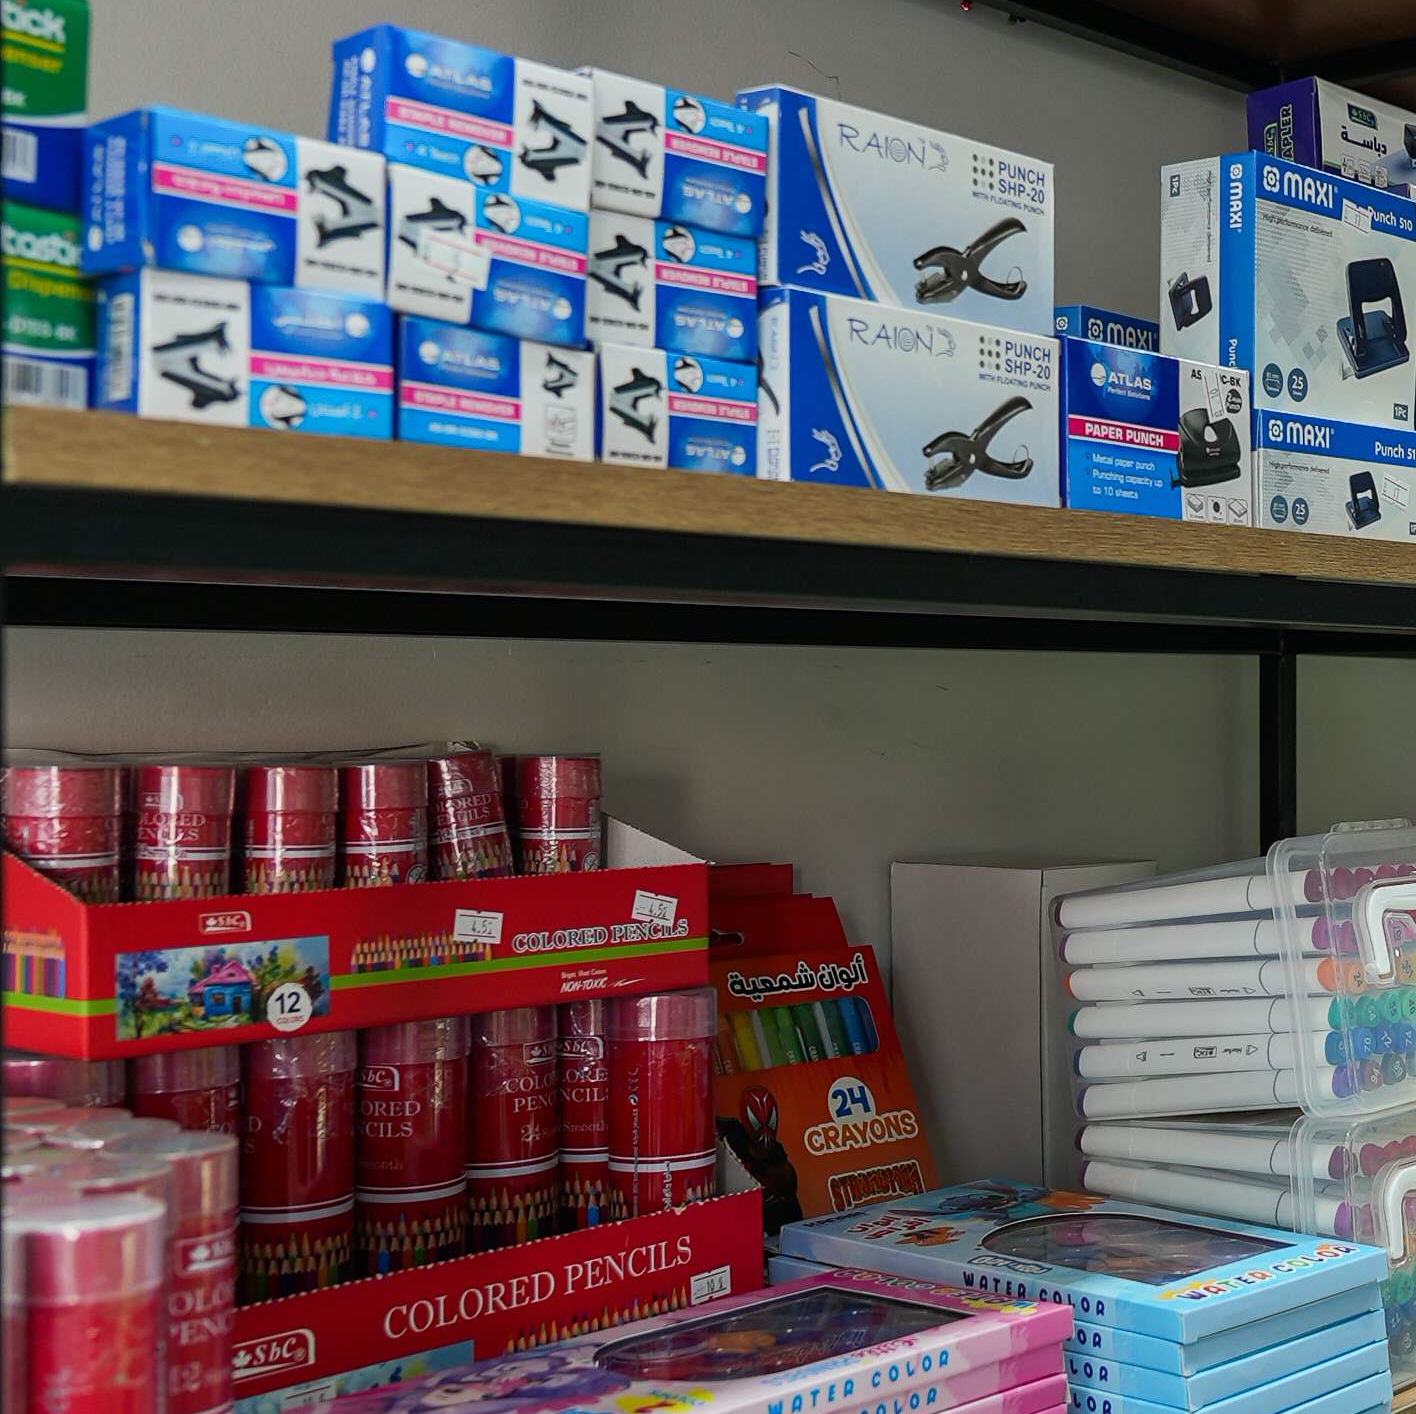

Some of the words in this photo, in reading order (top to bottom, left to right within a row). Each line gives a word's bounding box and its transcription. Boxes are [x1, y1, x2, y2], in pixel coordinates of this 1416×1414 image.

[428, 65, 493, 92] ATLAS
[838, 124, 926, 168] RAION
[1341, 125, 1388, 158] دباسة
[998, 160, 1045, 188] PUNCH
[1170, 175, 1180, 195] 1Pc
[972, 190, 989, 201] WITH
[990, 194, 1022, 211] FLOATING
[1023, 202, 1045, 217] PUNCH
[998, 178, 1045, 205] SHP-20
[1283, 171, 1334, 209] MAXI
[1229, 183, 1244, 229] MAXI
[1399, 216, 1413, 232] 510
[847, 318, 934, 357] RAION
[1106, 322, 1154, 351] MAXI
[1005, 340, 1051, 363] PUNCH
[1228, 338, 1238, 368] Punc
[979, 372, 995, 384] WITH
[997, 375, 1029, 389] FLOATING
[1031, 380, 1051, 393] PUNCH
[1005, 358, 1051, 381] SHP-20
[1108, 371, 1152, 391] ATLAS
[1291, 375, 1304, 389] 25
[1394, 405, 1408, 419] 1Pc
[1085, 422, 1124, 440] PAPER
[1125, 428, 1164, 447] PUNCH
[1286, 421, 1331, 449] MAXI
[1115, 457, 1134, 469] paper
[1135, 459, 1155, 471] punch
[1374, 441, 1405, 460] Punch
[1092, 469, 1124, 484] Punching
[1295, 503, 1306, 516] 25
[512, 926, 608, 954] COLORED
[610, 918, 690, 944] PENCILS
[560, 976, 609, 994] NON-TOXIC
[728, 961, 816, 1002] شمعية
[819, 954, 868, 992] ألوان
[274, 990, 301, 1016] 12
[1405, 1030, 1413, 1046] 74
[831, 1085, 871, 1119] 24
[806, 1112, 917, 1154] CRAYONS
[1176, 1269, 1272, 1301] WATER
[1270, 1242, 1358, 1274] COLOR
[383, 1267, 555, 1340] COLORED
[563, 1234, 693, 1298] PENCILS
[962, 1270, 1028, 1298] WATER
[1038, 1287, 1105, 1317] COLOR
[870, 1349, 950, 1389] COLOR
